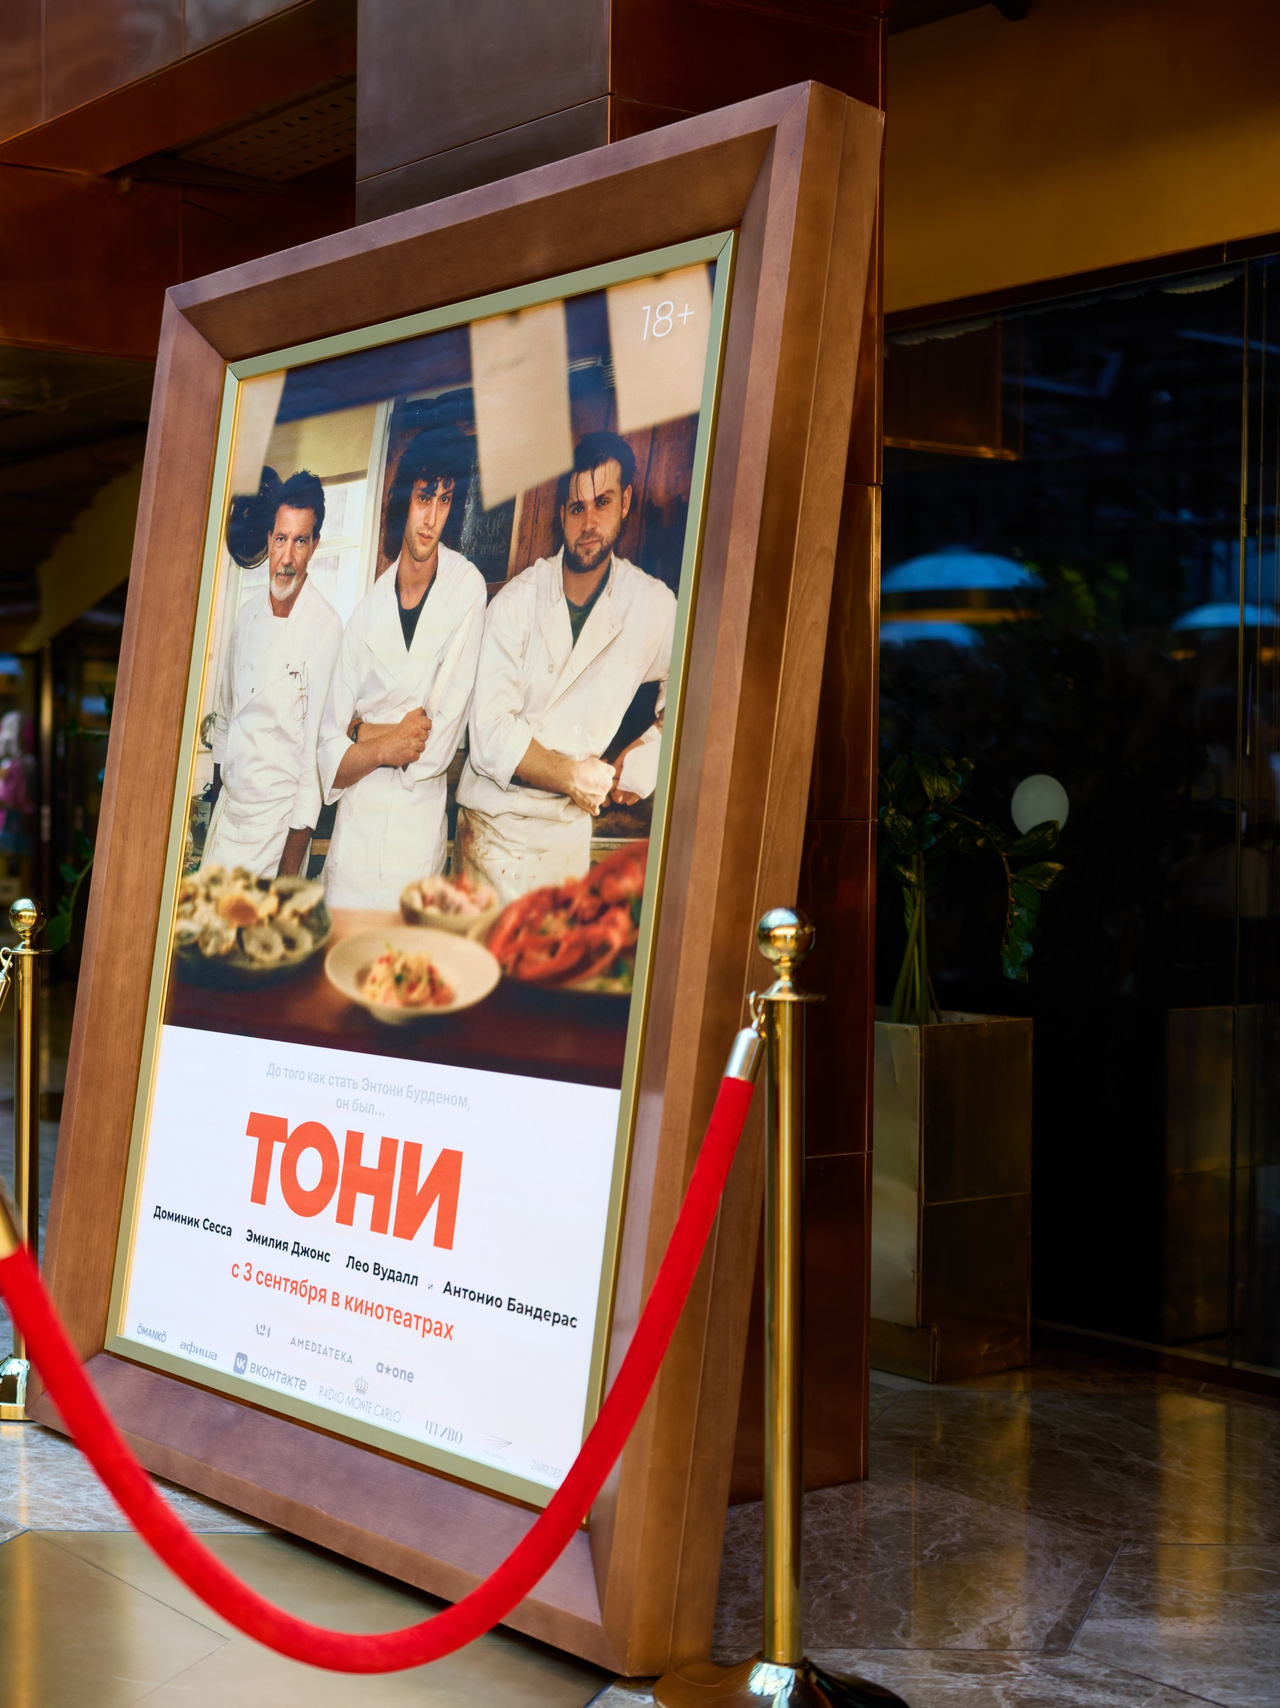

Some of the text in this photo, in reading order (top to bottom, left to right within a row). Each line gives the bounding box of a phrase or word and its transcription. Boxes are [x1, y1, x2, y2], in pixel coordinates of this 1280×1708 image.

[642, 301, 695, 341] 18+
[266, 1062, 471, 1112] До того как стать Энтони Бурденом,
[336, 1098, 385, 1116] он был...
[246, 1111, 463, 1250] ТОНИ
[153, 1206, 200, 1228] Доминик
[203, 1218, 232, 1237] Сесса
[246, 1229, 288, 1252] Эмилия
[291, 1241, 330, 1262] Джонс
[346, 1256, 369, 1273] Лео
[373, 1262, 418, 1286] Вудалл
[443, 1281, 502, 1308] Антонио
[507, 1297, 577, 1328] Бандерас
[232, 1262, 454, 1340] с 3 сентября в кинотеатрах
[180, 1342, 217, 1360] афиша
[290, 1337, 352, 1364] AMEDIATEKA
[318, 1386, 401, 1423] RADIO MONTE CARLO
